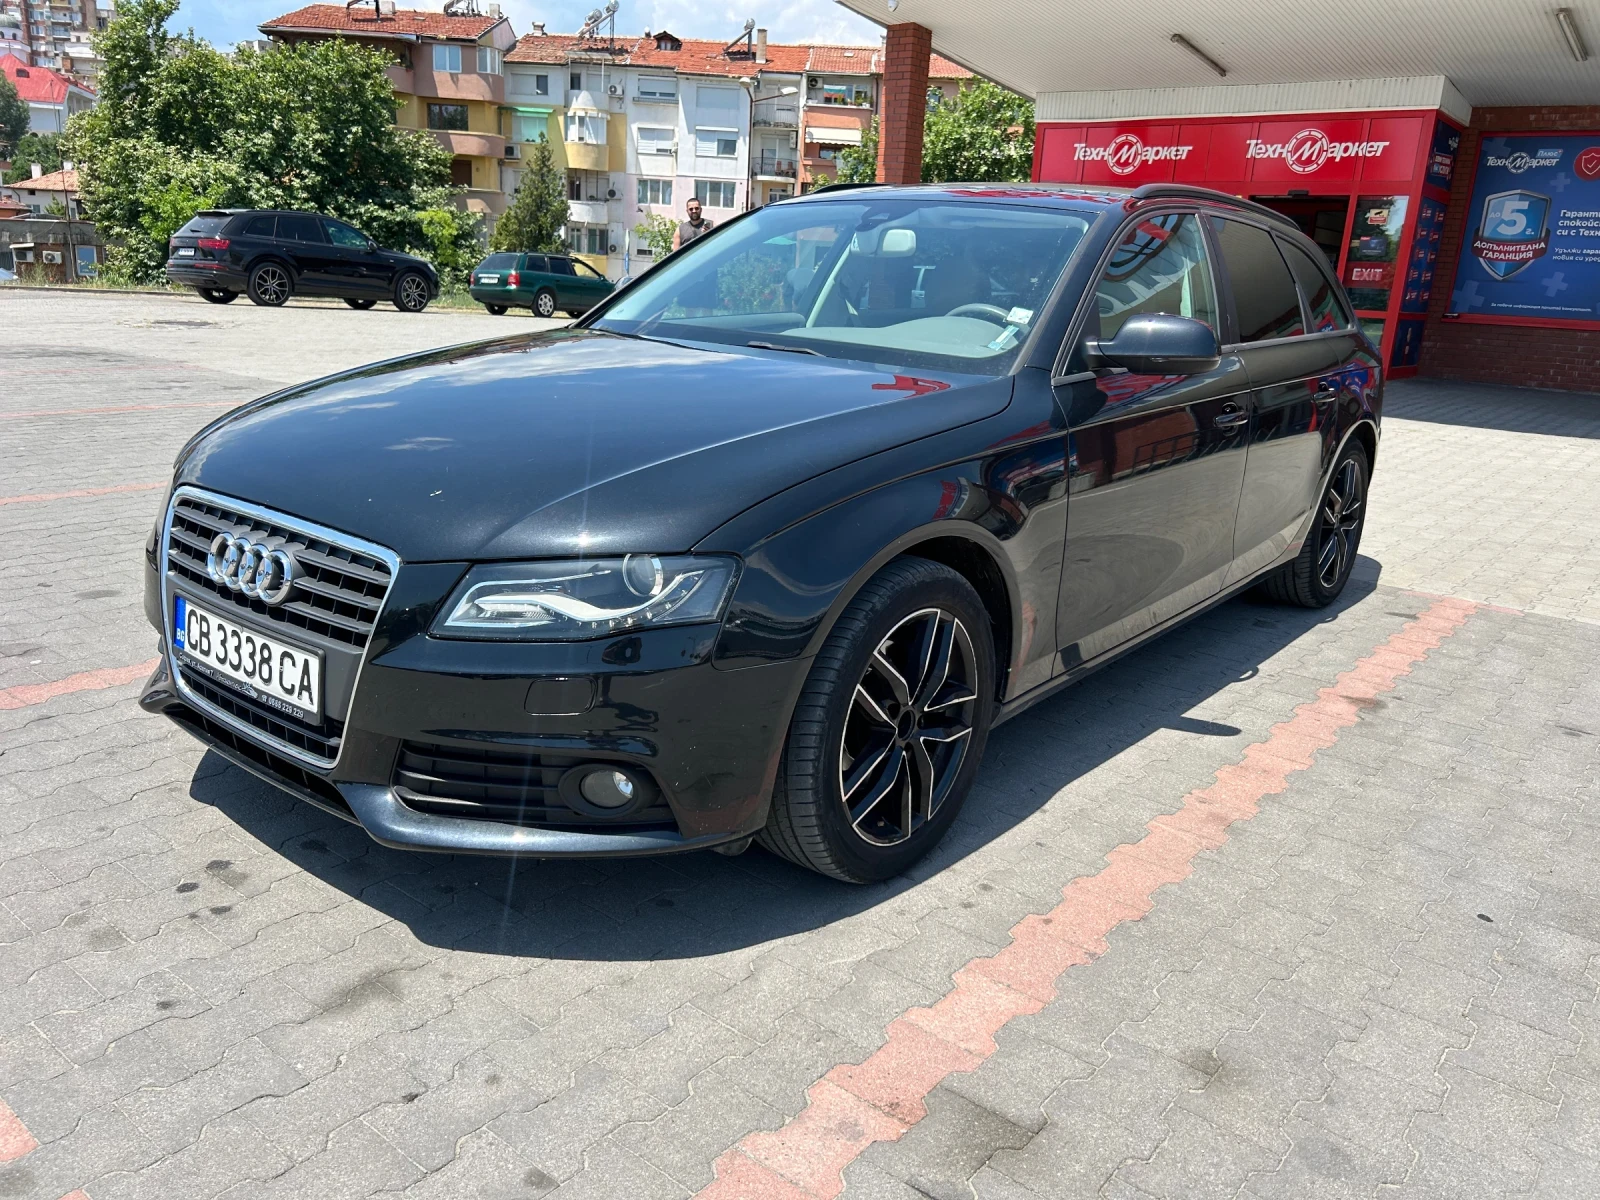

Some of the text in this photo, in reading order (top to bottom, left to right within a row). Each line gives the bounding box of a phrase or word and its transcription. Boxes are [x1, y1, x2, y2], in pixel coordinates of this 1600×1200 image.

[1496, 200, 1530, 235] 5
[1558, 219, 1600, 227] спокойс
[1473, 240, 1546, 252] ДОПЪЛНИТЕЛНА
[1482, 250, 1533, 260] ГАРАНЦИЯ
[1352, 268, 1383, 281] EXIT
[176, 628, 185, 642] BG
[187, 608, 211, 657] CB
[215, 623, 273, 686] 3338
[279, 650, 314, 706] CA
